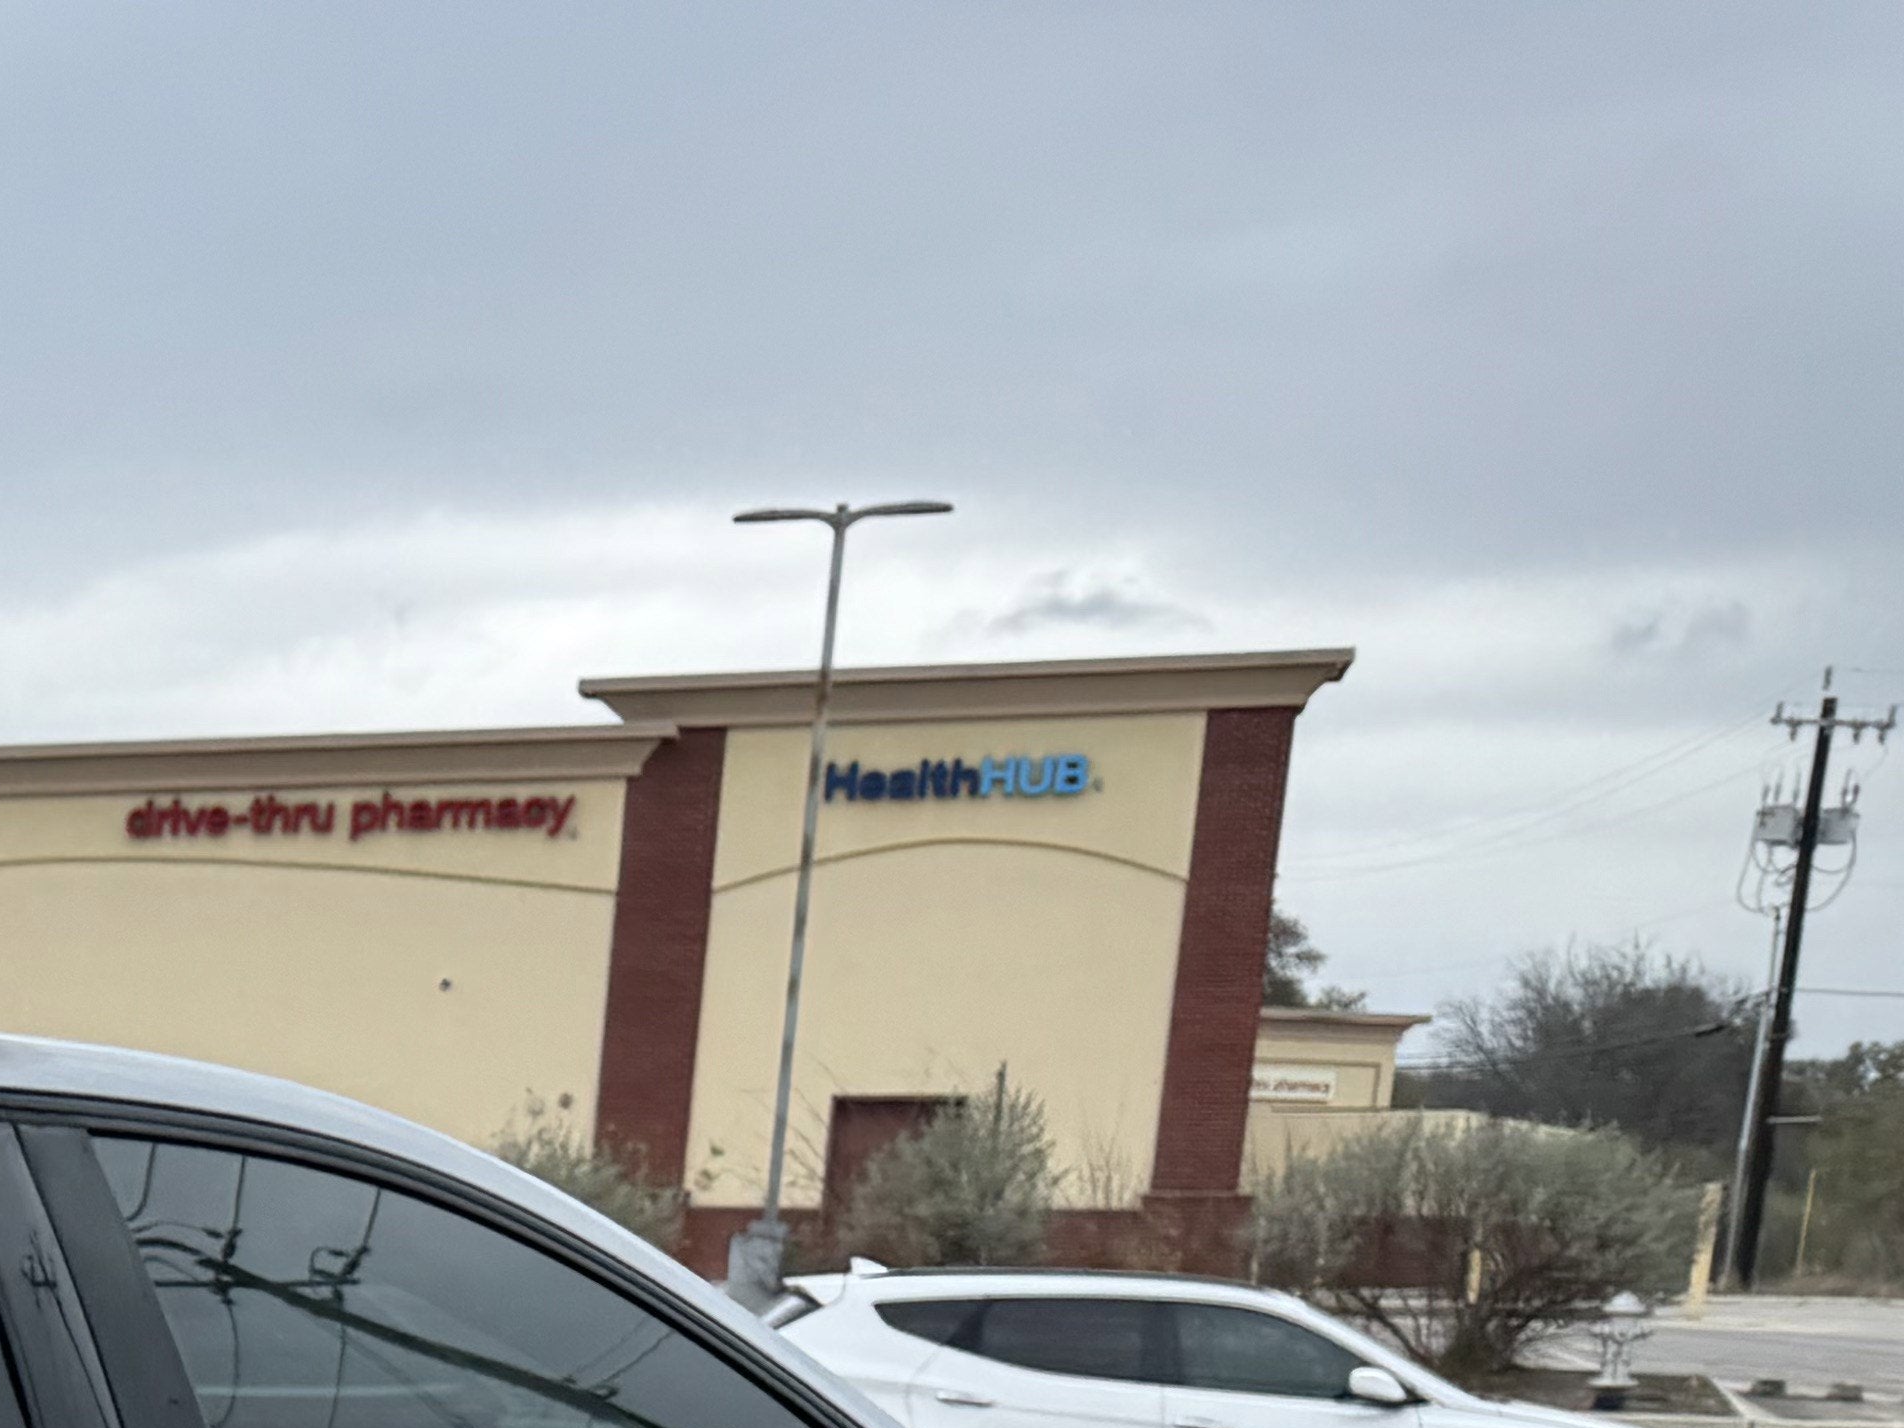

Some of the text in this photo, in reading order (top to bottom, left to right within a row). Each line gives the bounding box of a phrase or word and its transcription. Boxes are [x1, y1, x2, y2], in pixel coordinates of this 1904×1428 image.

[824, 754, 1089, 803] HealthHUB
[125, 790, 576, 842] drive-thru pharmacy
